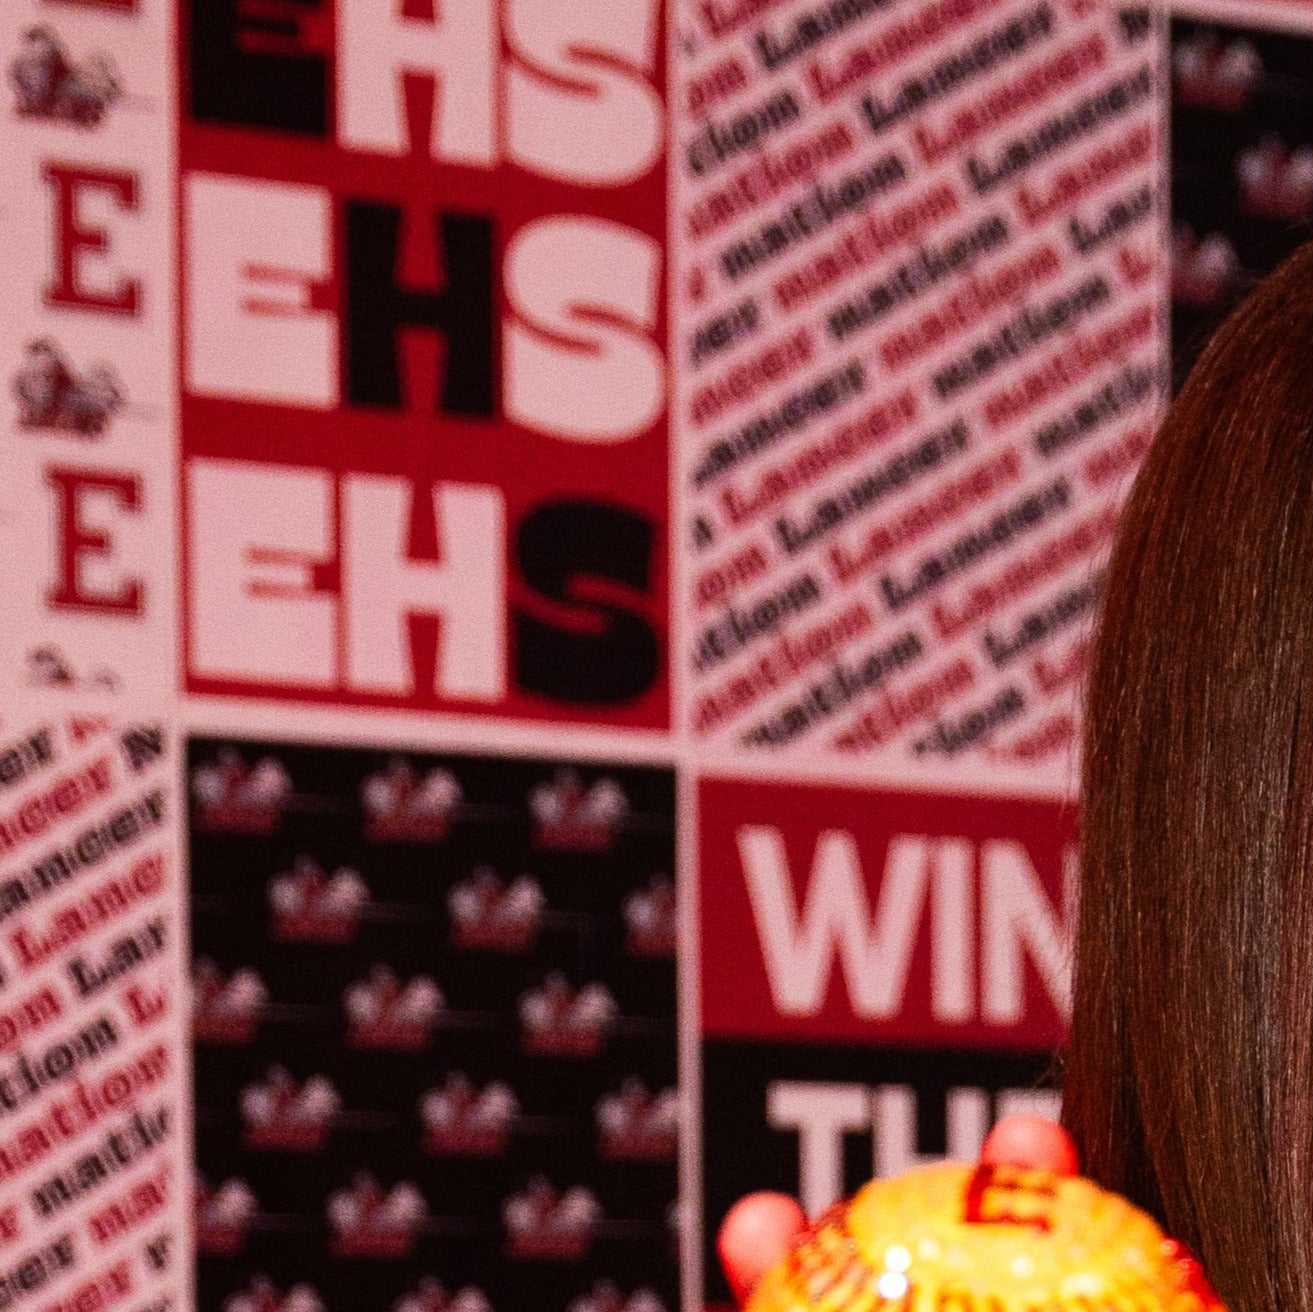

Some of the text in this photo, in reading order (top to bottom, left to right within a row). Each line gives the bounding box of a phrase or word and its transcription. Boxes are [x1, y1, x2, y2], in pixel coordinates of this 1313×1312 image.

[41, 159, 142, 319] E
[186, 172, 667, 444] EHS
[45, 464, 146, 619] E
[187, 457, 660, 709] EHS
[736, 823, 1079, 1024] WIN
[765, 1080, 1063, 1222] TH
